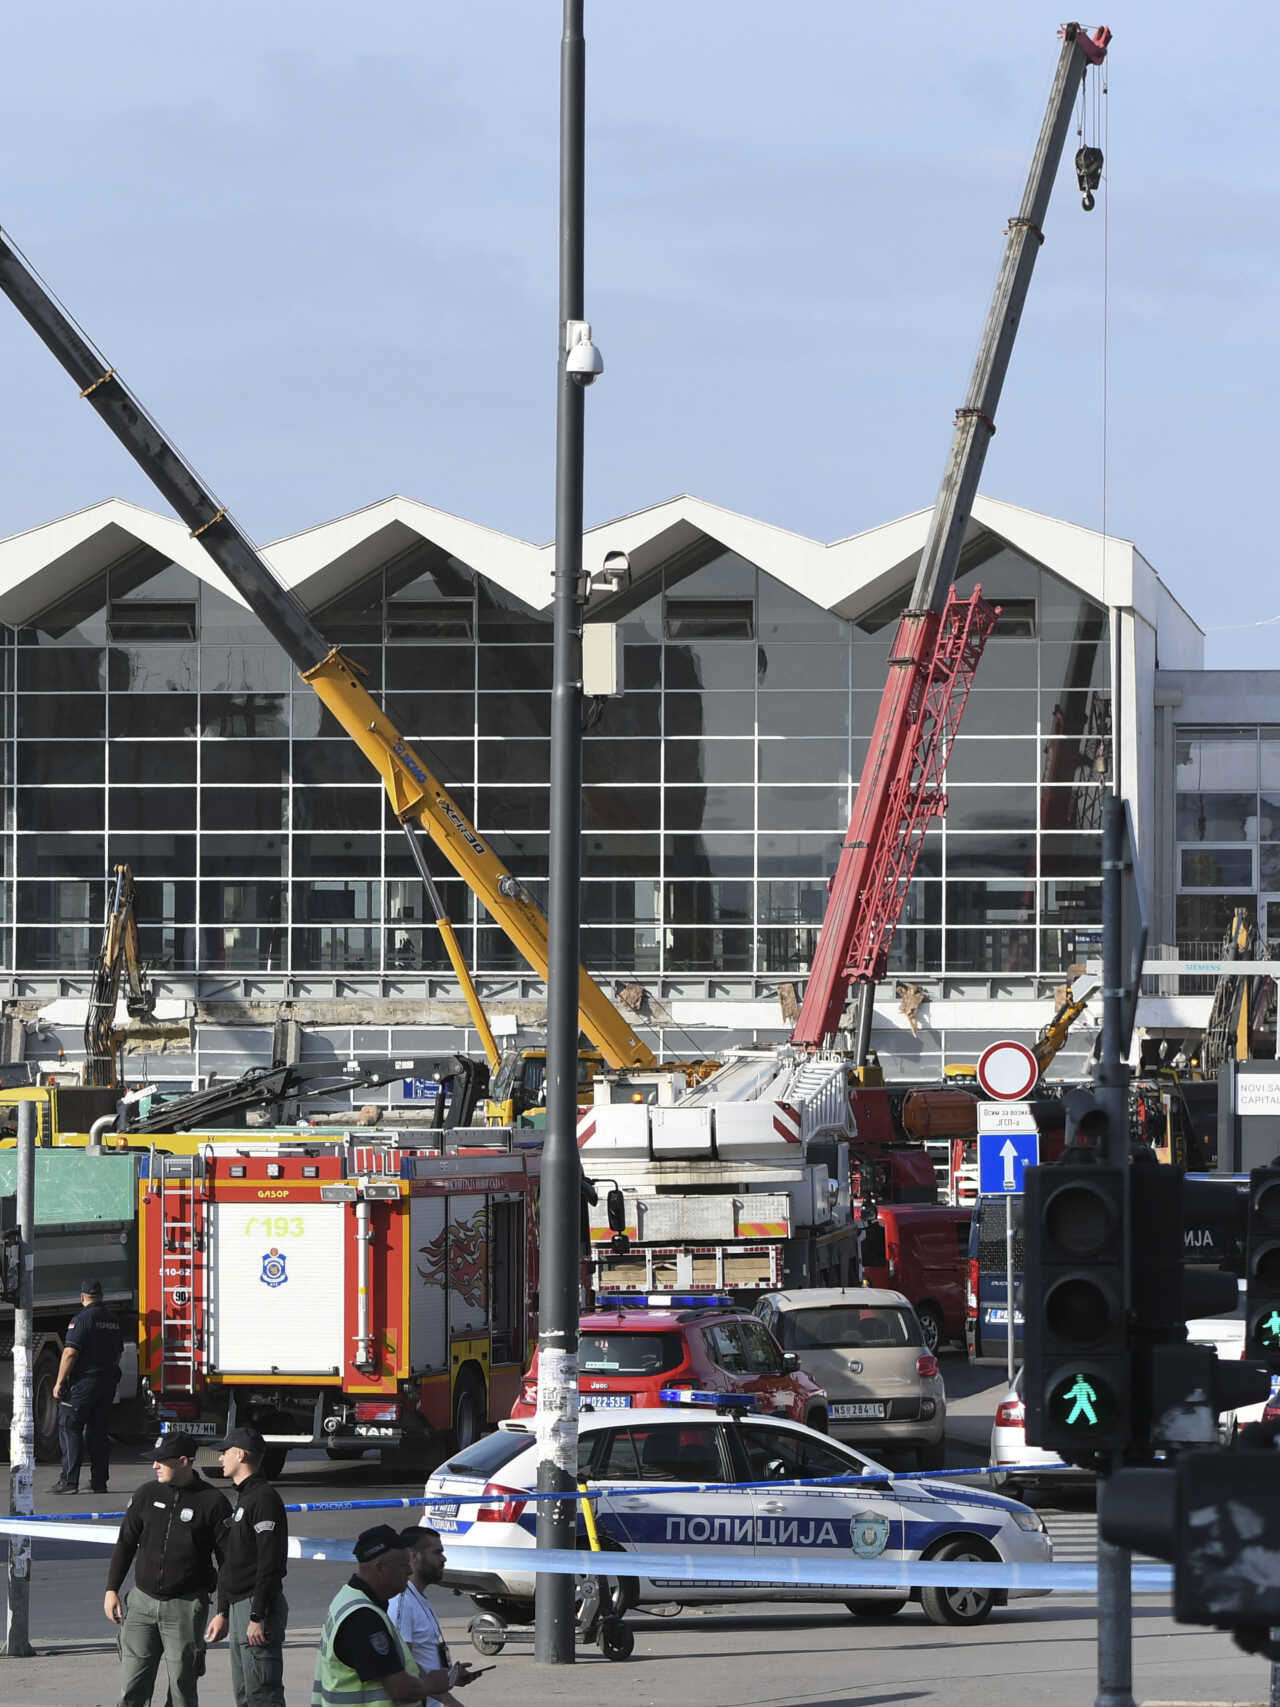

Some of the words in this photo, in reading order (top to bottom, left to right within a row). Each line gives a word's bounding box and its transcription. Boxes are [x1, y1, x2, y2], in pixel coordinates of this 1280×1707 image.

[1240, 1084, 1265, 1092] NOVI
[260, 1217, 305, 1238] 193
[175, 1291, 186, 1302] 90
[592, 1396, 626, 1407] 022-535
[355, 1427, 393, 1436] MAN
[666, 1517, 838, 1545] ПОЛИЦИЈА
